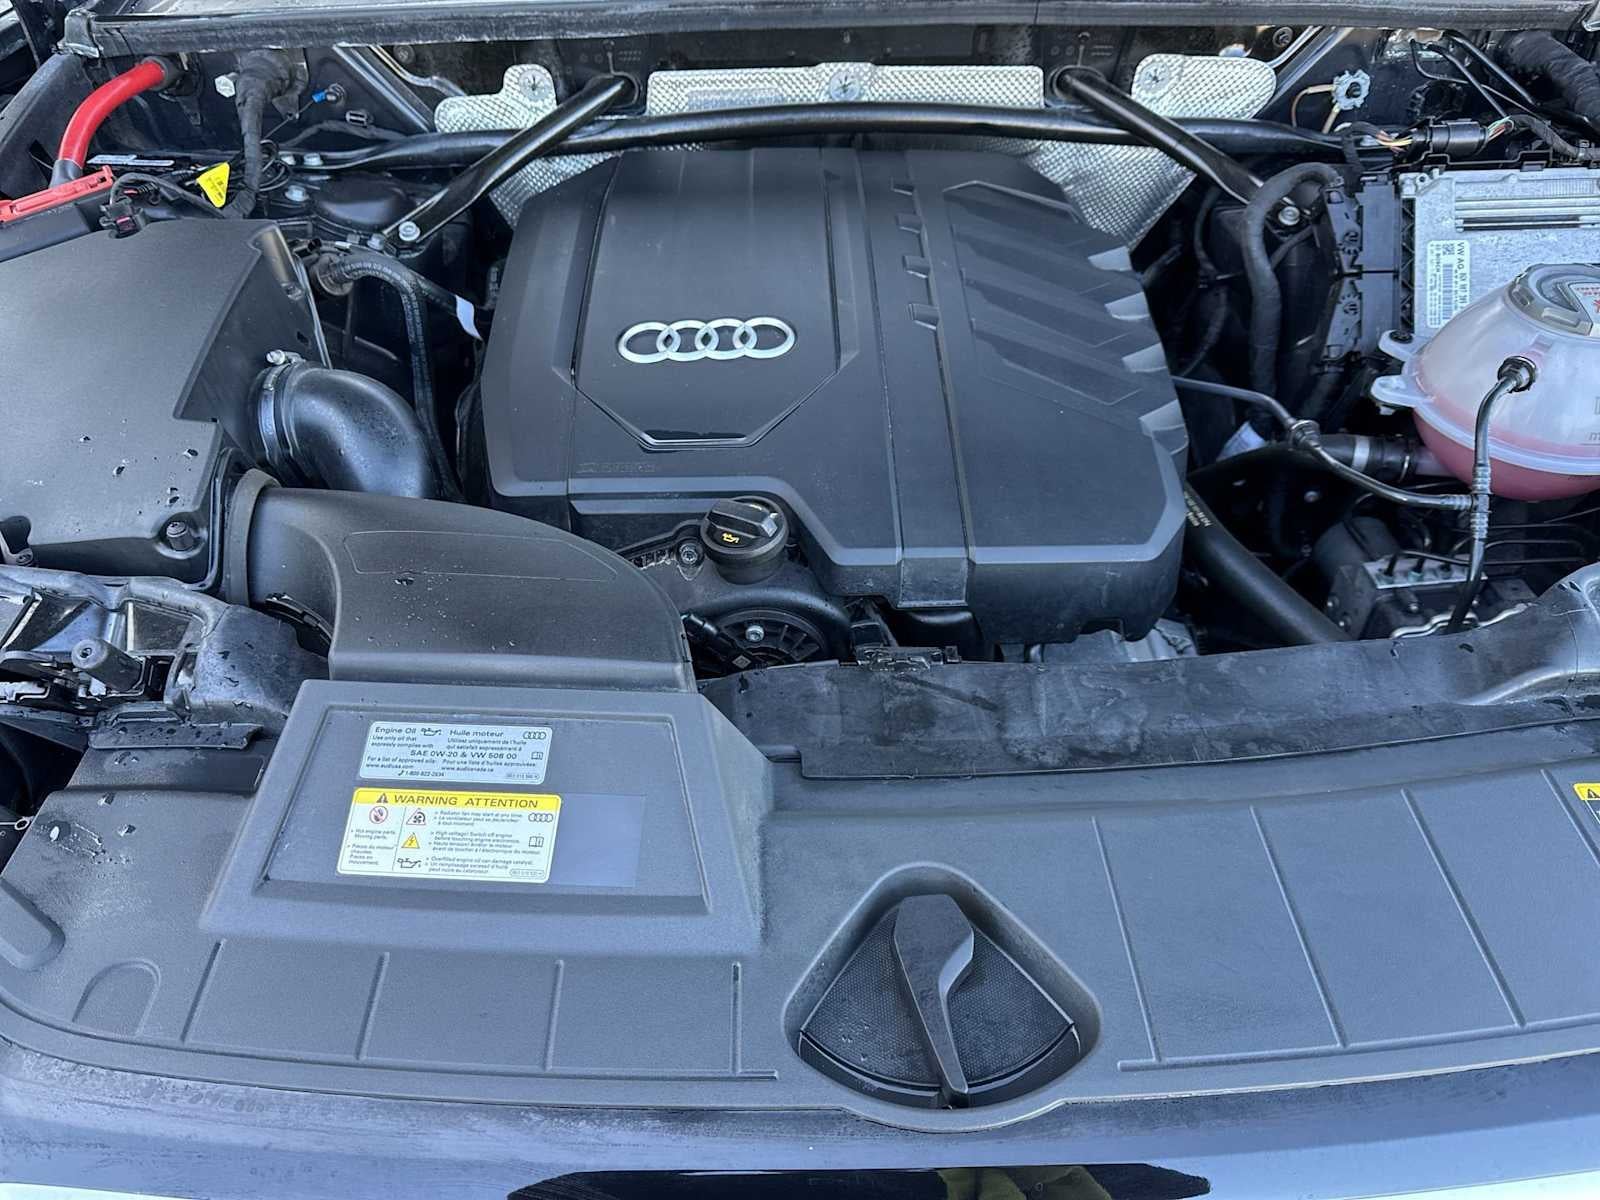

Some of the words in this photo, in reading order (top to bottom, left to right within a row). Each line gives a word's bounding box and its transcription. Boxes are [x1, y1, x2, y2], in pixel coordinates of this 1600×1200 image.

[1457, 242, 1465, 256] VW
[1457, 258, 1465, 270] AG
[375, 727, 403, 735] Engine
[404, 727, 417, 735] Oil
[449, 729, 471, 737] Huile
[430, 750, 458, 758] 0W-20
[394, 795, 459, 806] WARNING
[464, 798, 539, 808] ATTENTION
